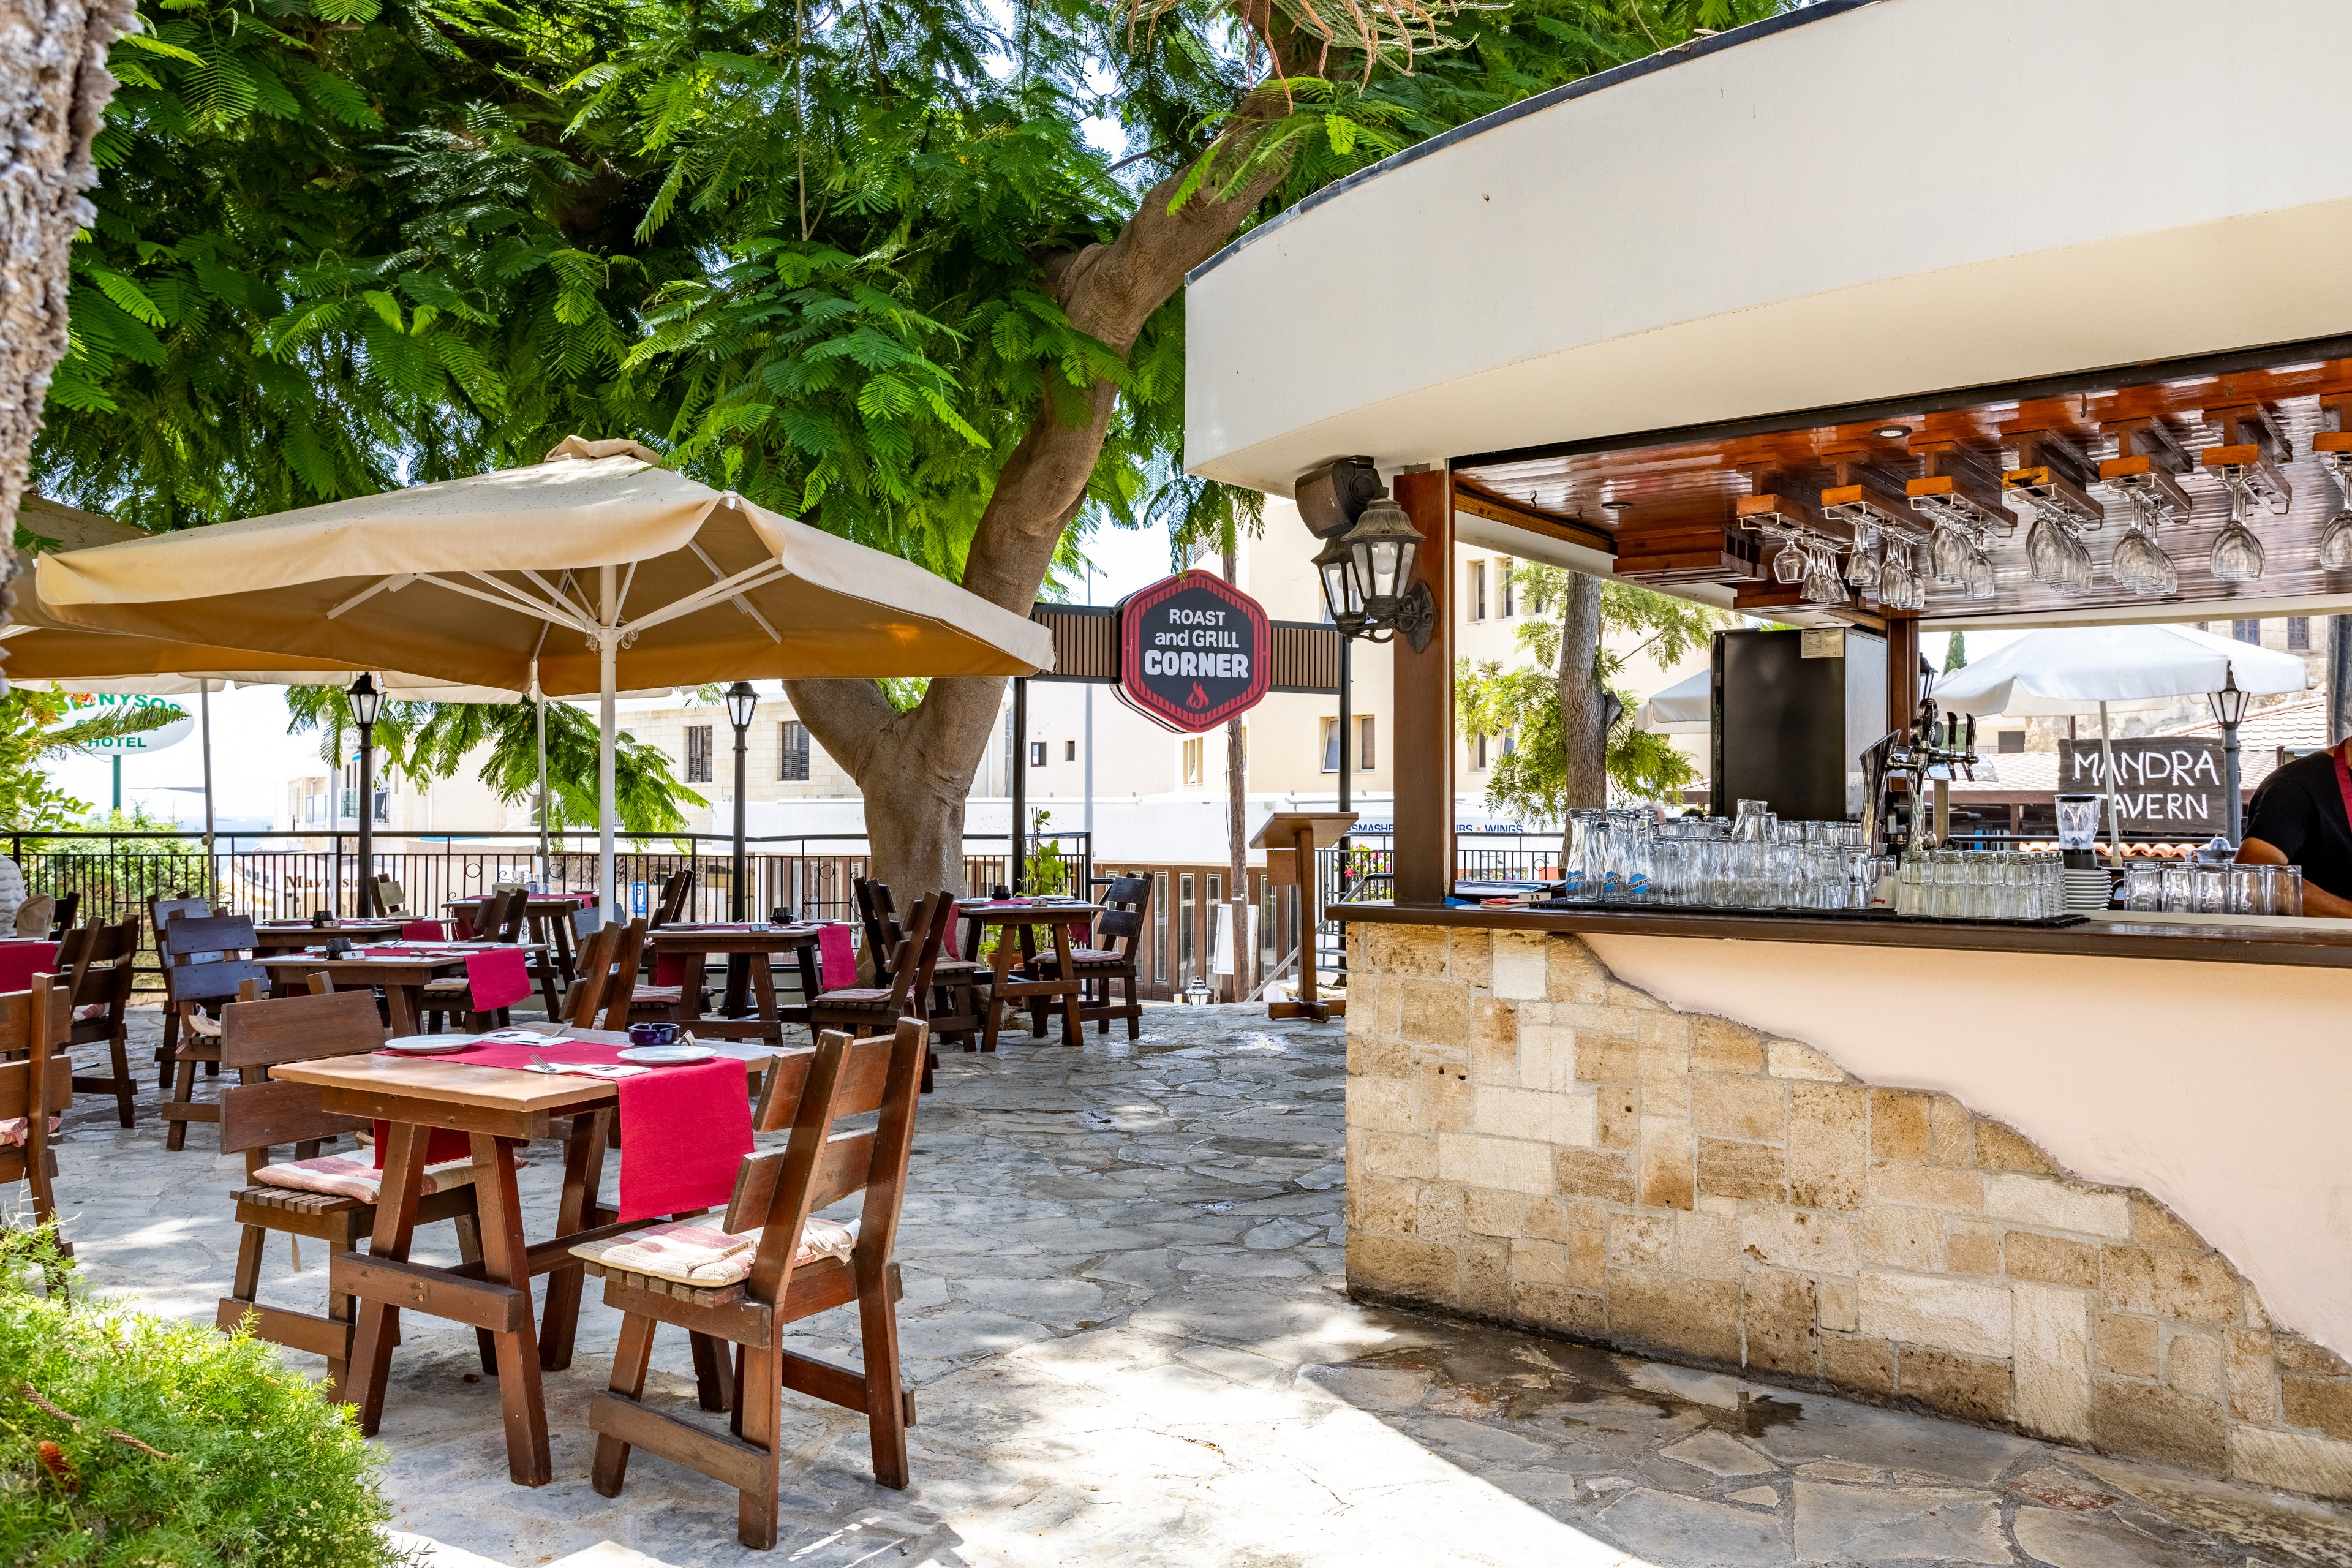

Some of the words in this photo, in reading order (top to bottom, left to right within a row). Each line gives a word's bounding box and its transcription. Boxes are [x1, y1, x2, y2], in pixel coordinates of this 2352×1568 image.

[1169, 609, 1225, 626] ROAST
[1155, 630, 1189, 646] and
[1192, 630, 1239, 648] GRILL
[1144, 649, 1248, 679] CORNER
[88, 736, 147, 748] HOTEL
[2074, 750, 2220, 786] MANDRA
